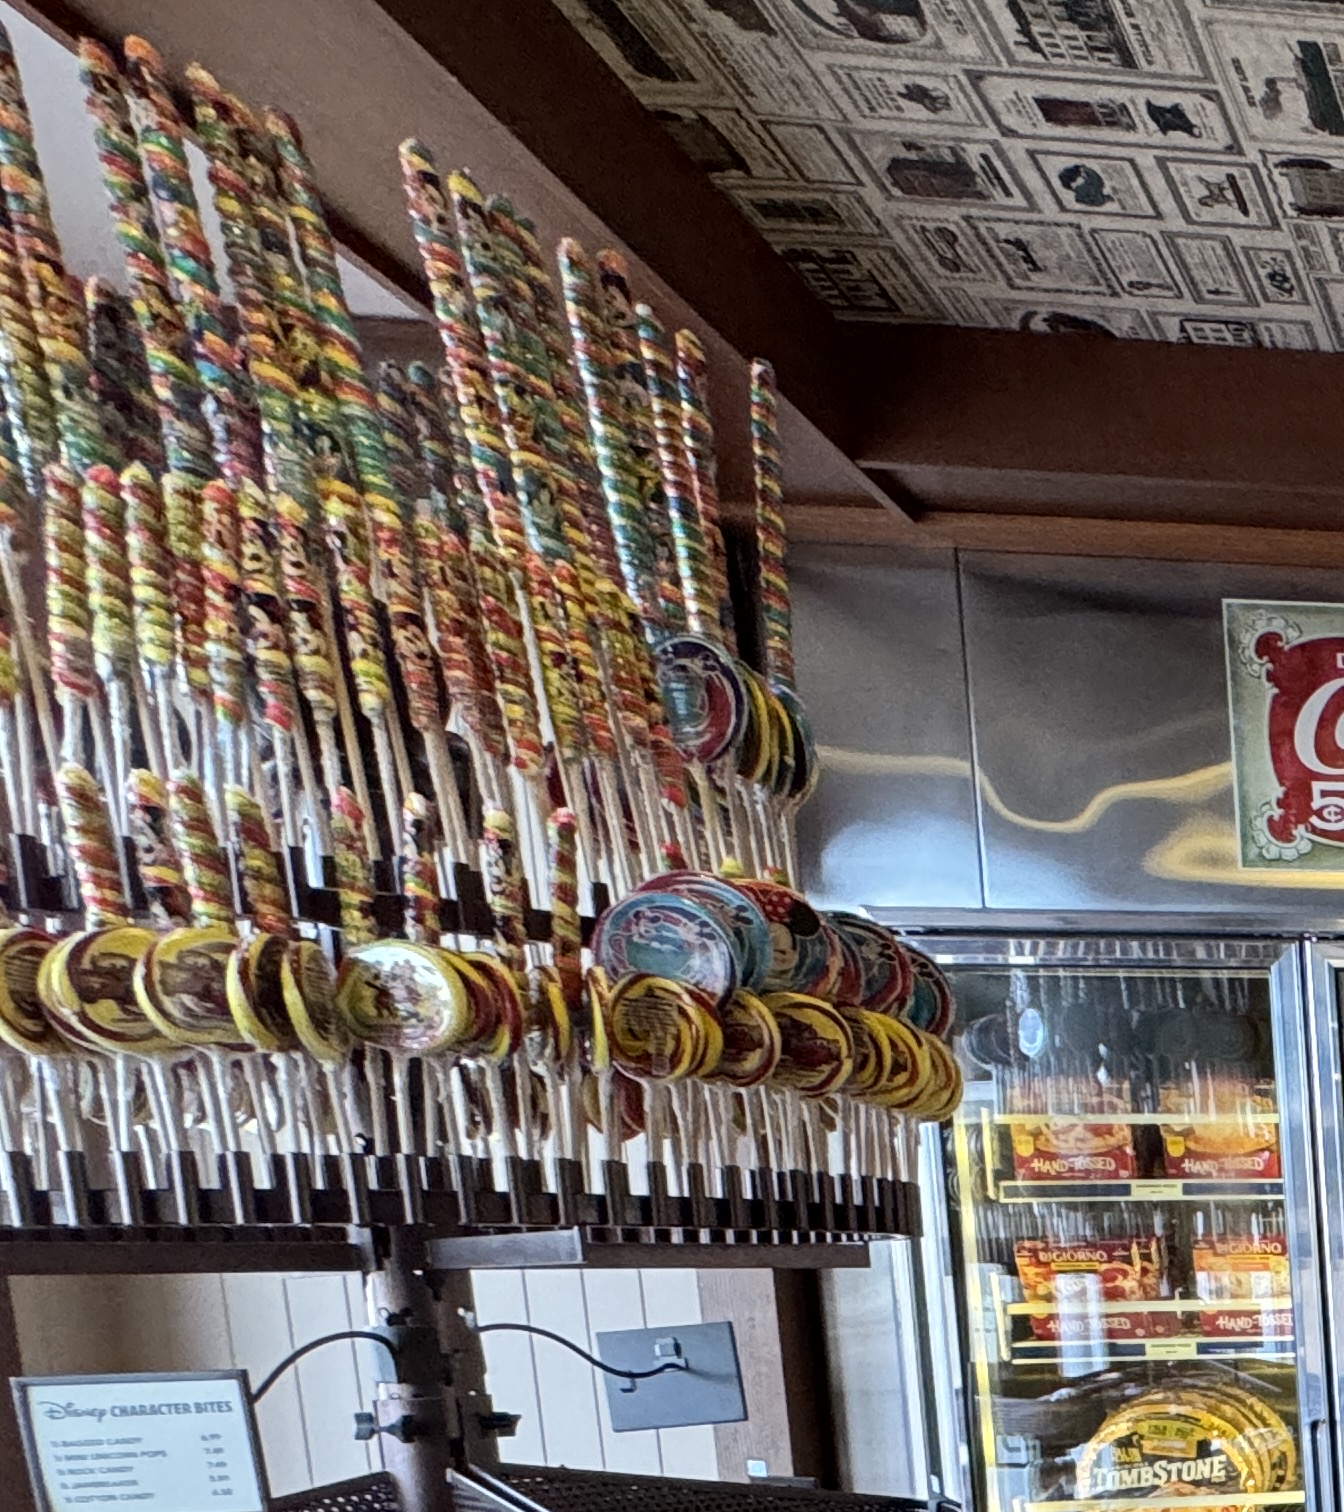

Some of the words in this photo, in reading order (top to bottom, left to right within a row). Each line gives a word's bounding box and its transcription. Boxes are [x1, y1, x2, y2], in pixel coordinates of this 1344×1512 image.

[38, 1401, 107, 1423] Disney
[110, 1402, 192, 1418] CHARACTER
[194, 1401, 233, 1414] BITES
[1093, 1455, 1228, 1490] TOMBSTONE
